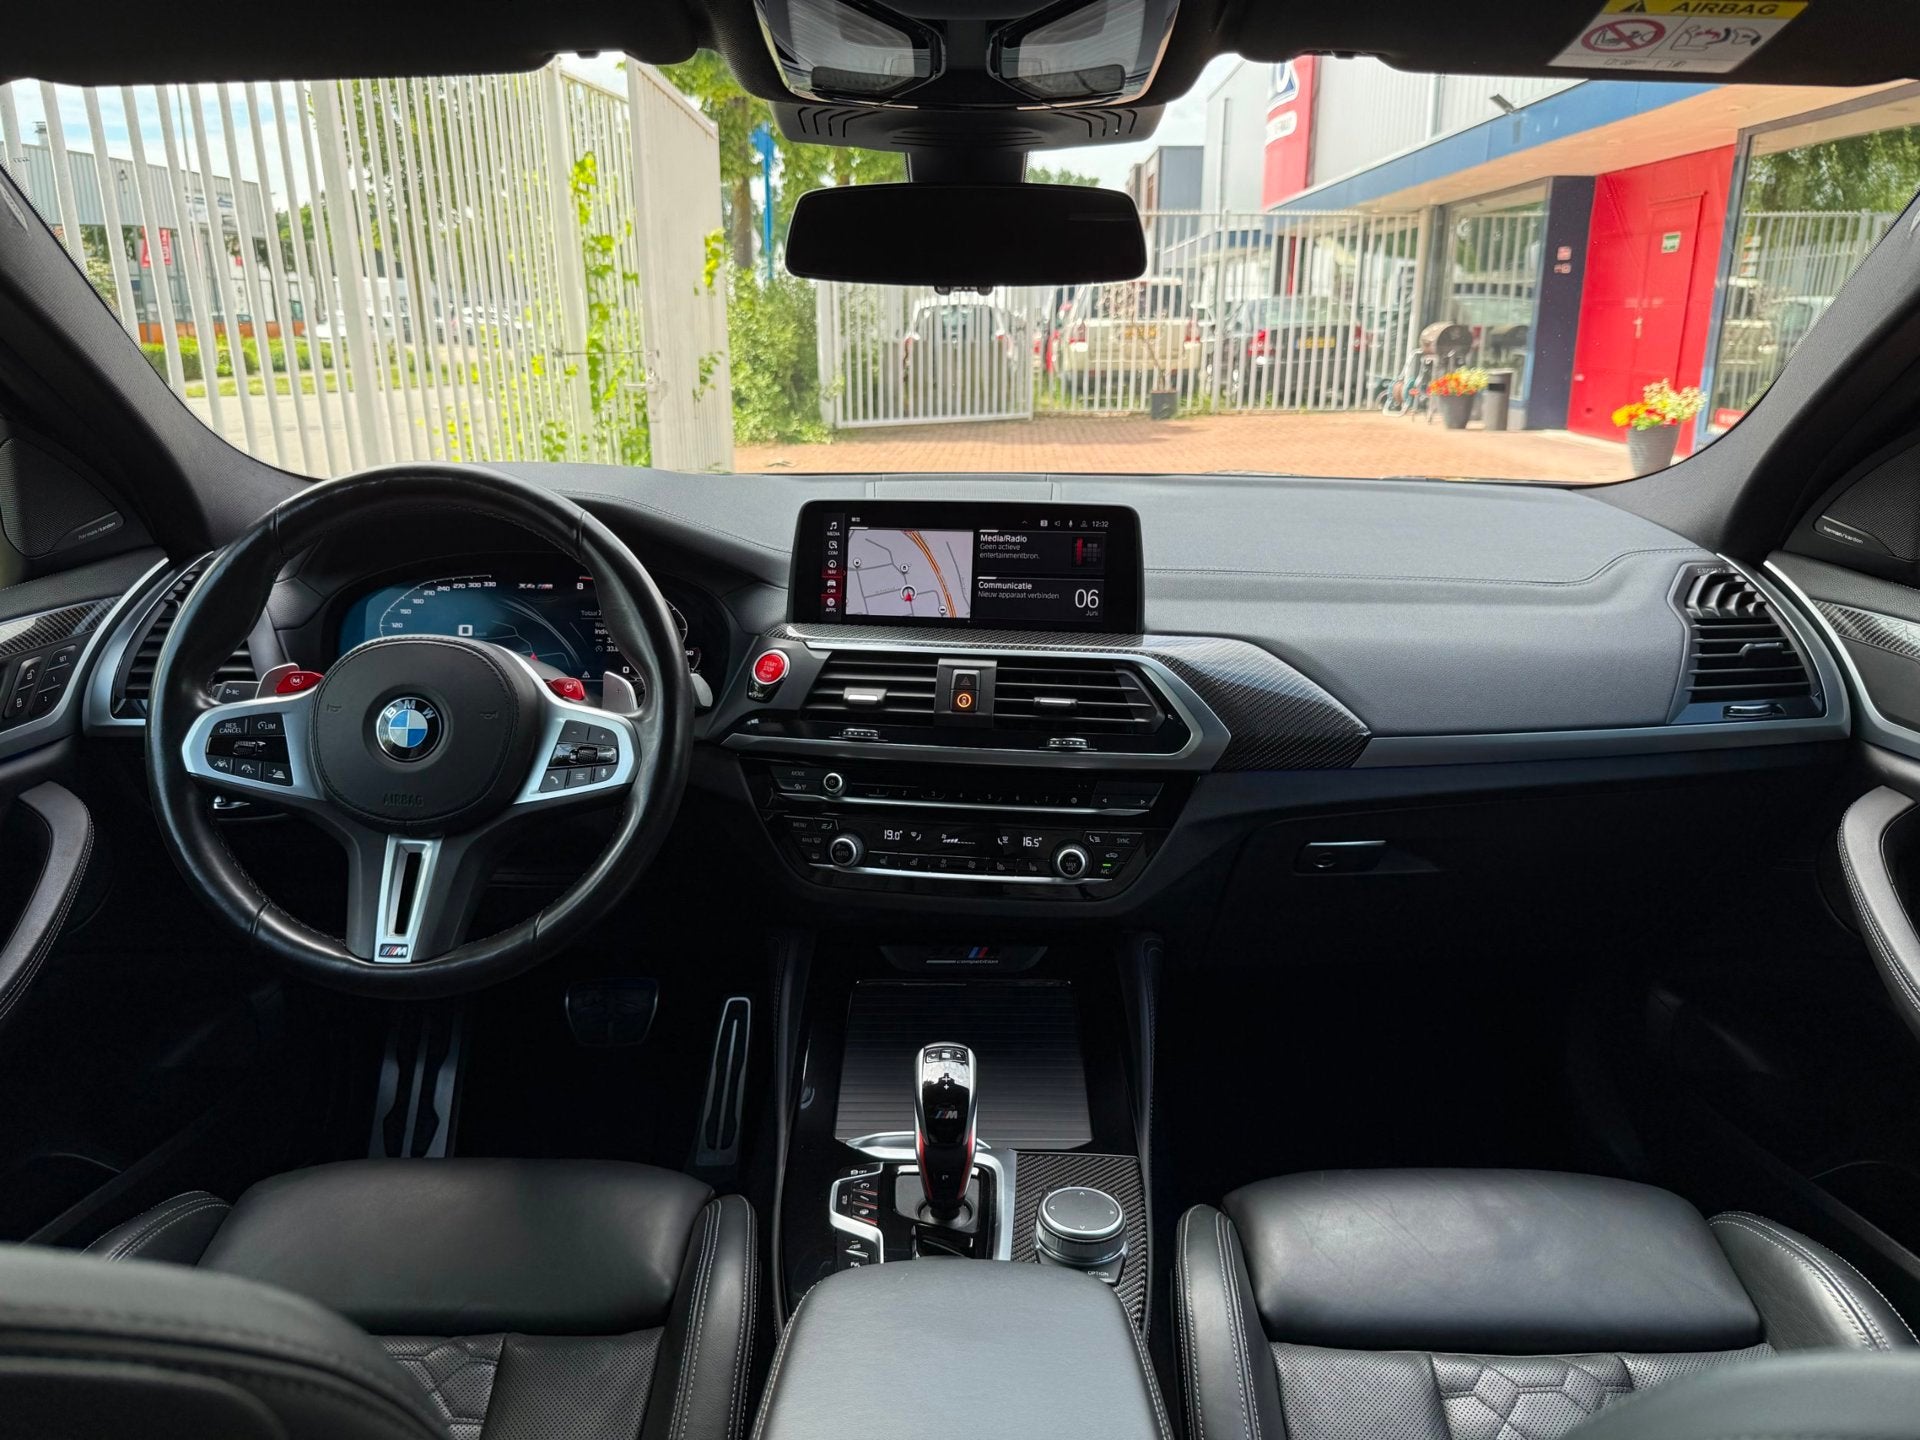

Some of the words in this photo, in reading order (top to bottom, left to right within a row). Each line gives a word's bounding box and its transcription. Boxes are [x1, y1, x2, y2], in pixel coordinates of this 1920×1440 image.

[1670, 2, 1779, 15] AIRBAG
[980, 534, 1027, 543] Media/Radio
[978, 581, 1032, 590] Communicatie
[1028, 591, 1060, 599] verbinden
[1075, 589, 1099, 608] 06
[458, 624, 473, 637] 0
[385, 699, 436, 720] BMW
[383, 794, 424, 807] AIRBAG
